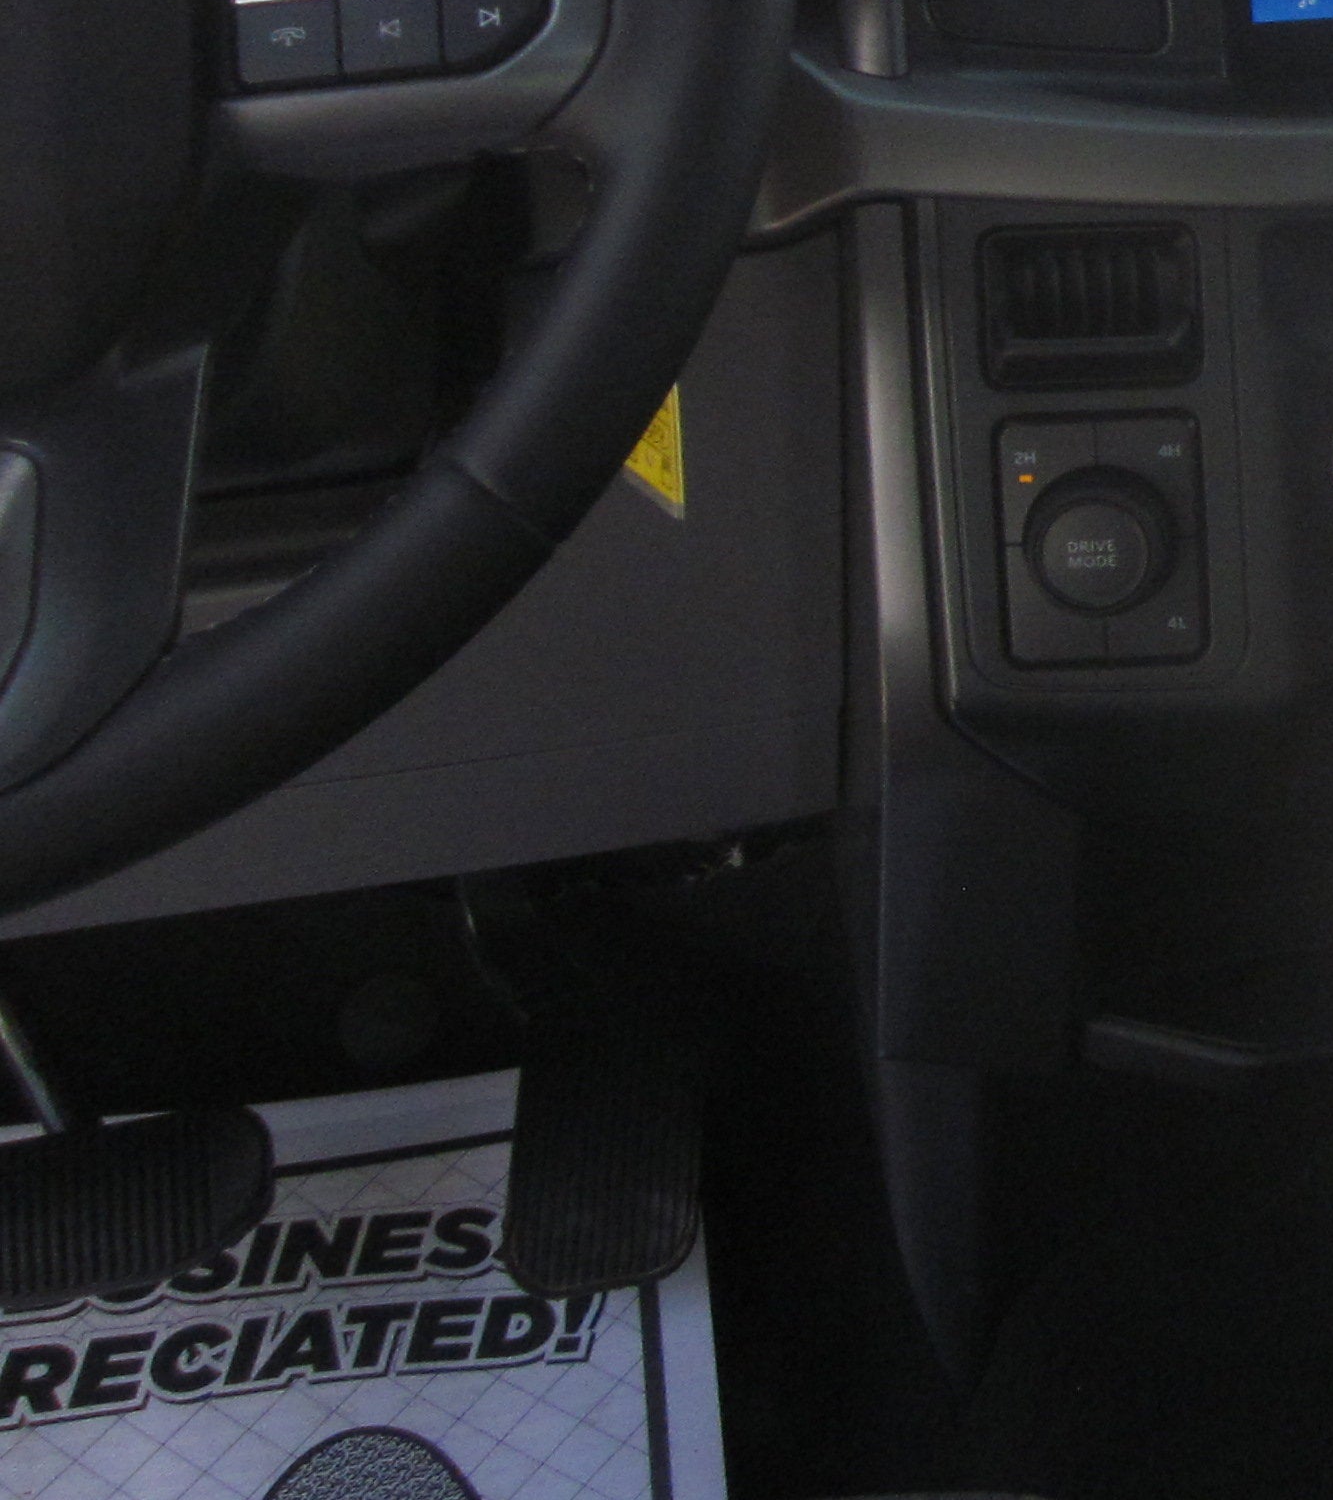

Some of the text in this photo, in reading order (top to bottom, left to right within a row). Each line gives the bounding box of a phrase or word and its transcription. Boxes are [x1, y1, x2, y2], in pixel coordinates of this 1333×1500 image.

[1013, 451, 1037, 465] 2H
[1157, 444, 1181, 458] 4H
[1067, 539, 1116, 553] DRIVE
[1068, 555, 1117, 568] MODE
[1167, 616, 1186, 629] 4L
